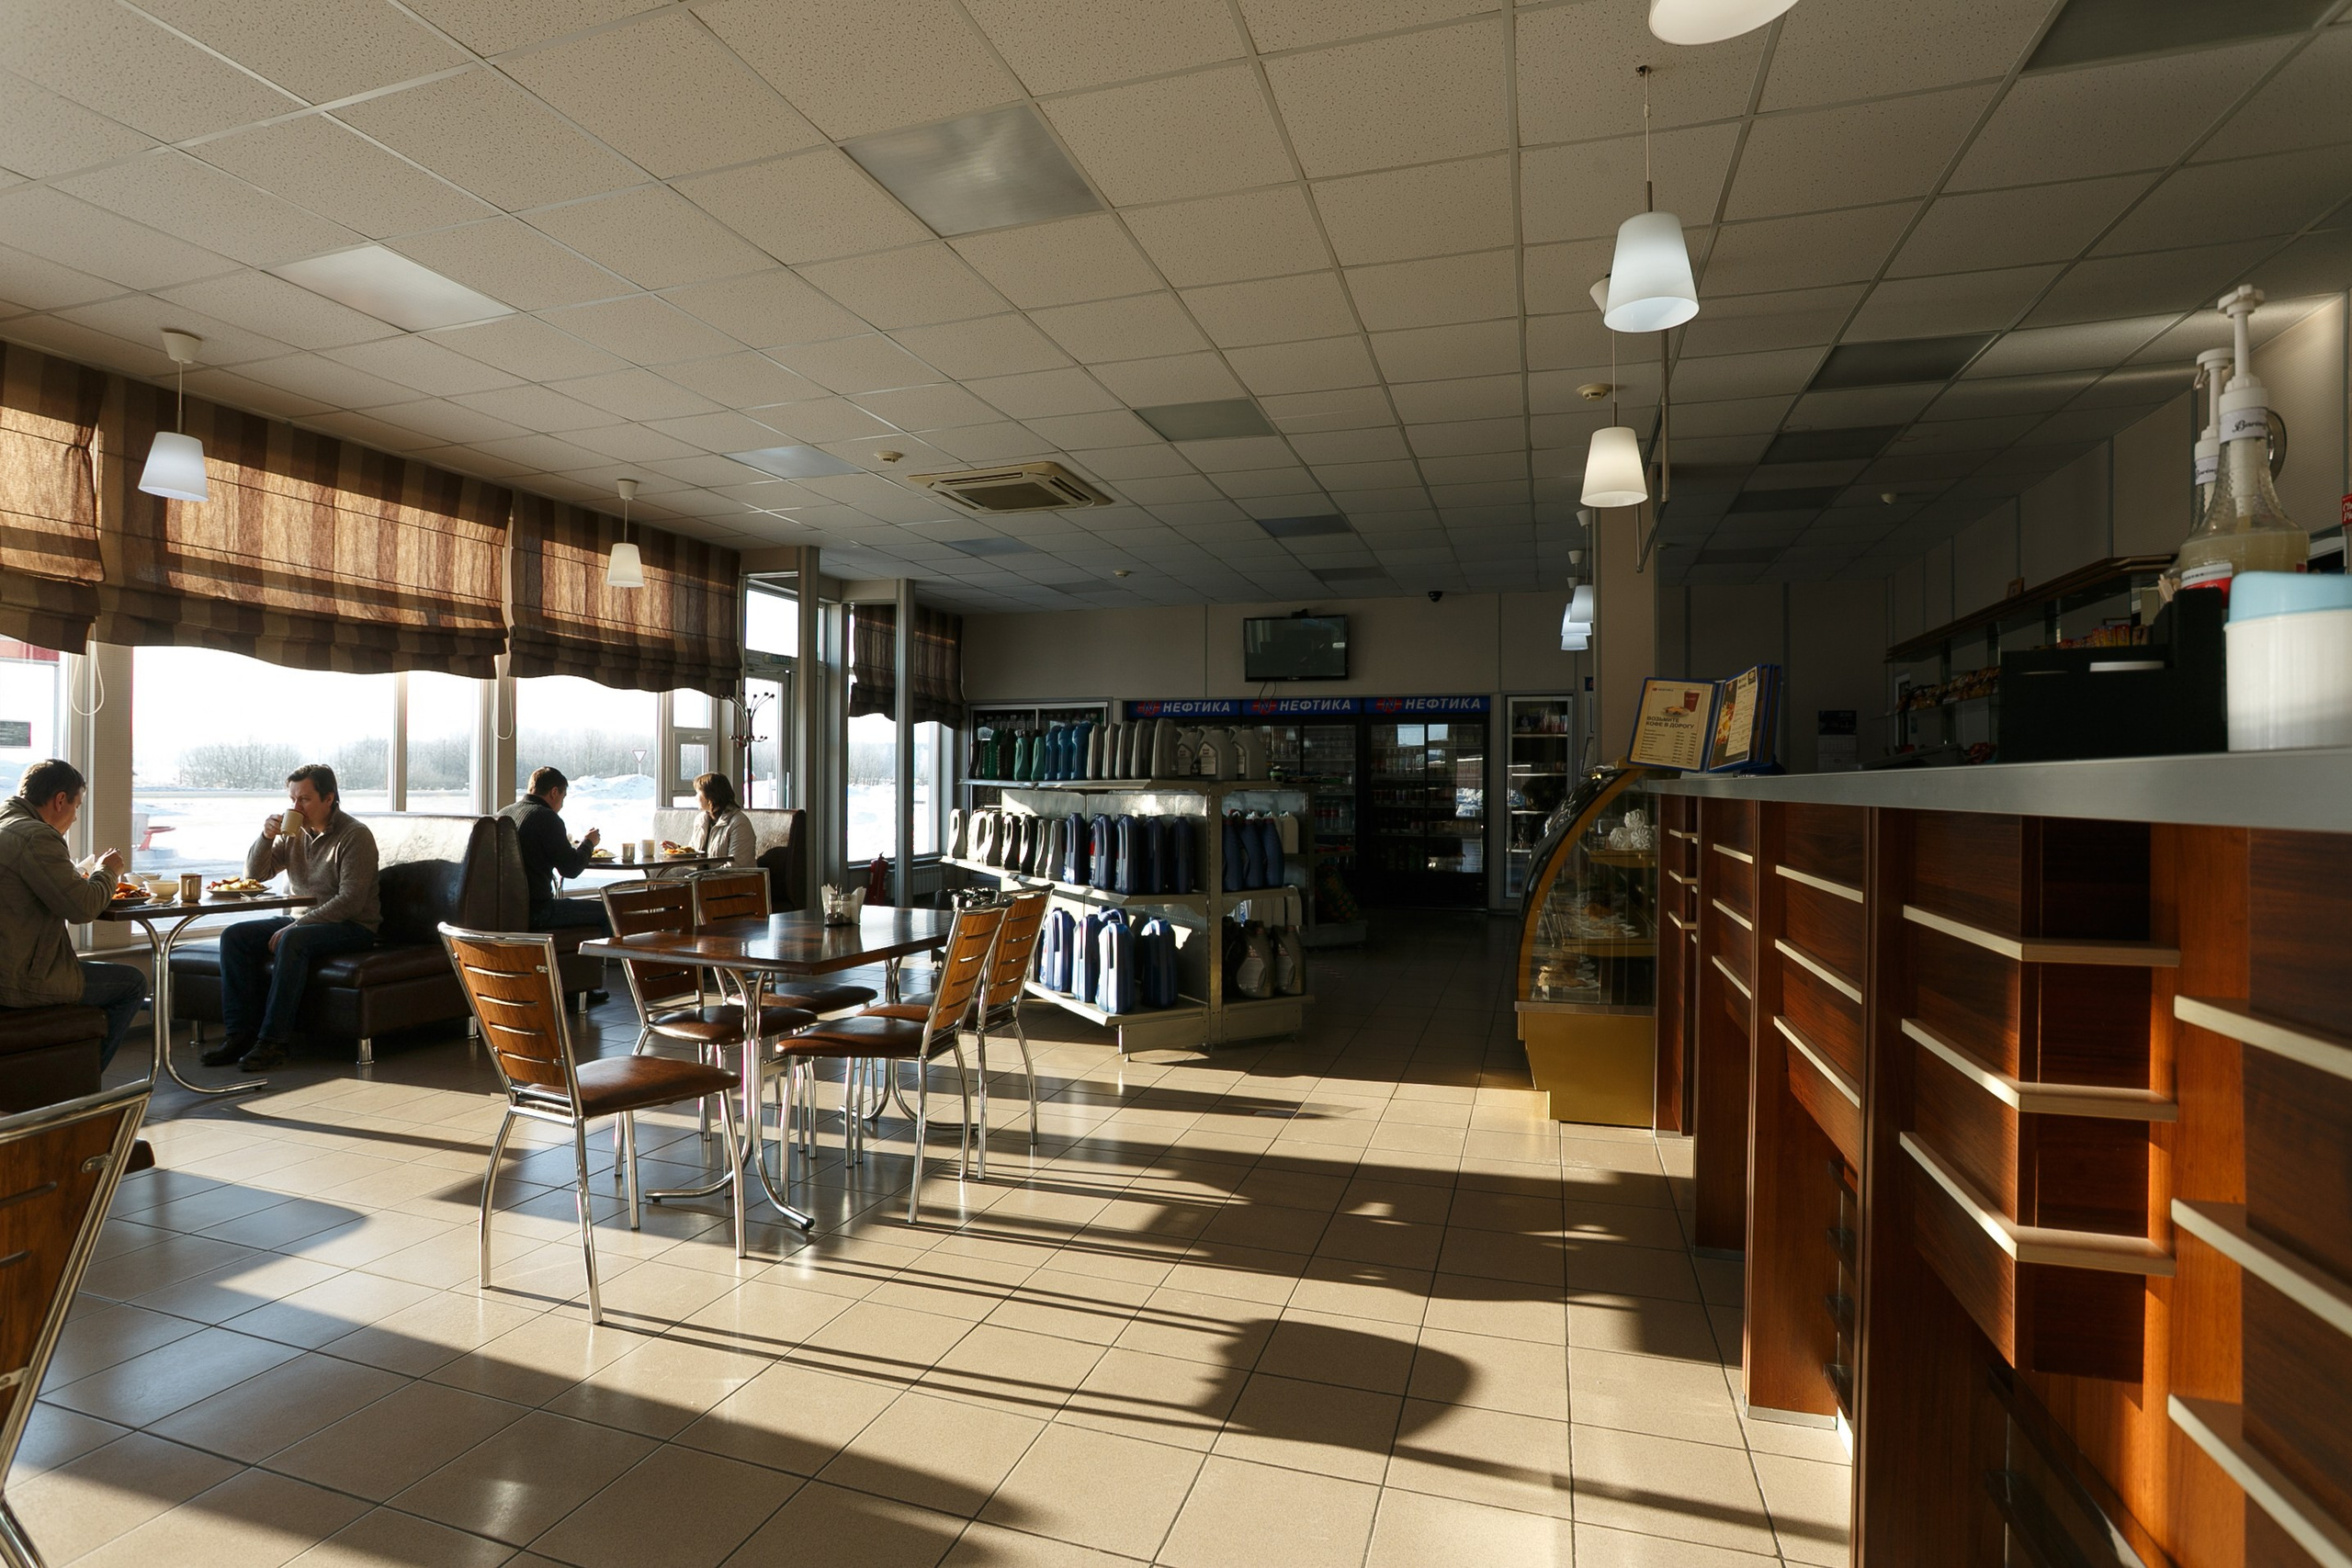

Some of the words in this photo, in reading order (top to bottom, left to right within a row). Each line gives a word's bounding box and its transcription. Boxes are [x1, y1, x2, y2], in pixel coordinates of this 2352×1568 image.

[1163, 702, 1230, 713] НЕФТИКА
[1280, 699, 1351, 711] НЕФТИКА
[1405, 697, 1480, 709] НЕФТИКА
